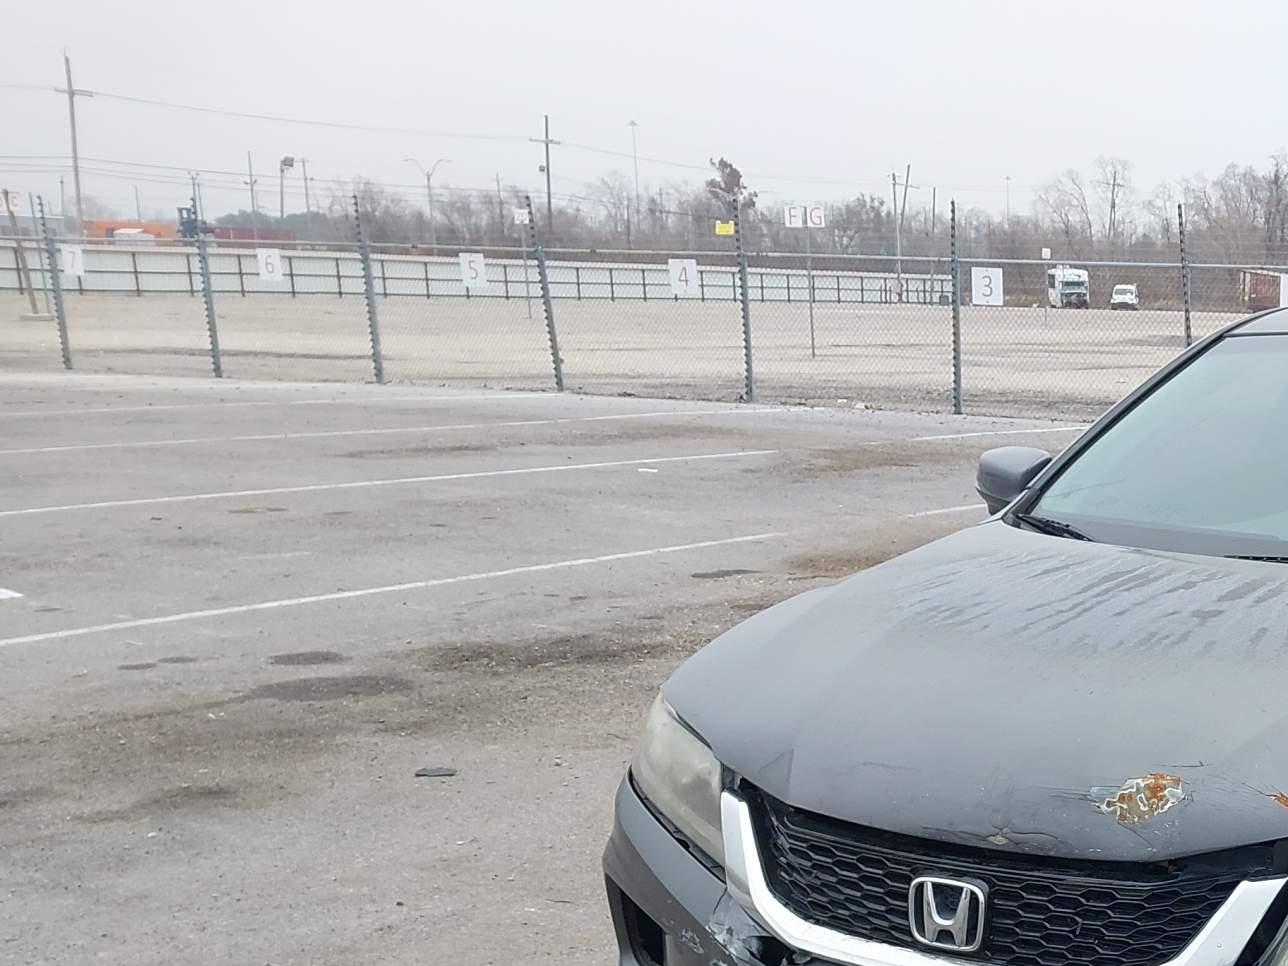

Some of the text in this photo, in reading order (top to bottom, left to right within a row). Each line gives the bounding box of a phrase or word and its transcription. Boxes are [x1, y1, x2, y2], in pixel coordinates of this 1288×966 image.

[788, 207, 823, 226] F G
[67, 251, 76, 268] 7
[264, 255, 275, 274] 6
[468, 259, 479, 280] 5
[678, 266, 690, 287] 4
[981, 275, 994, 297] 3
